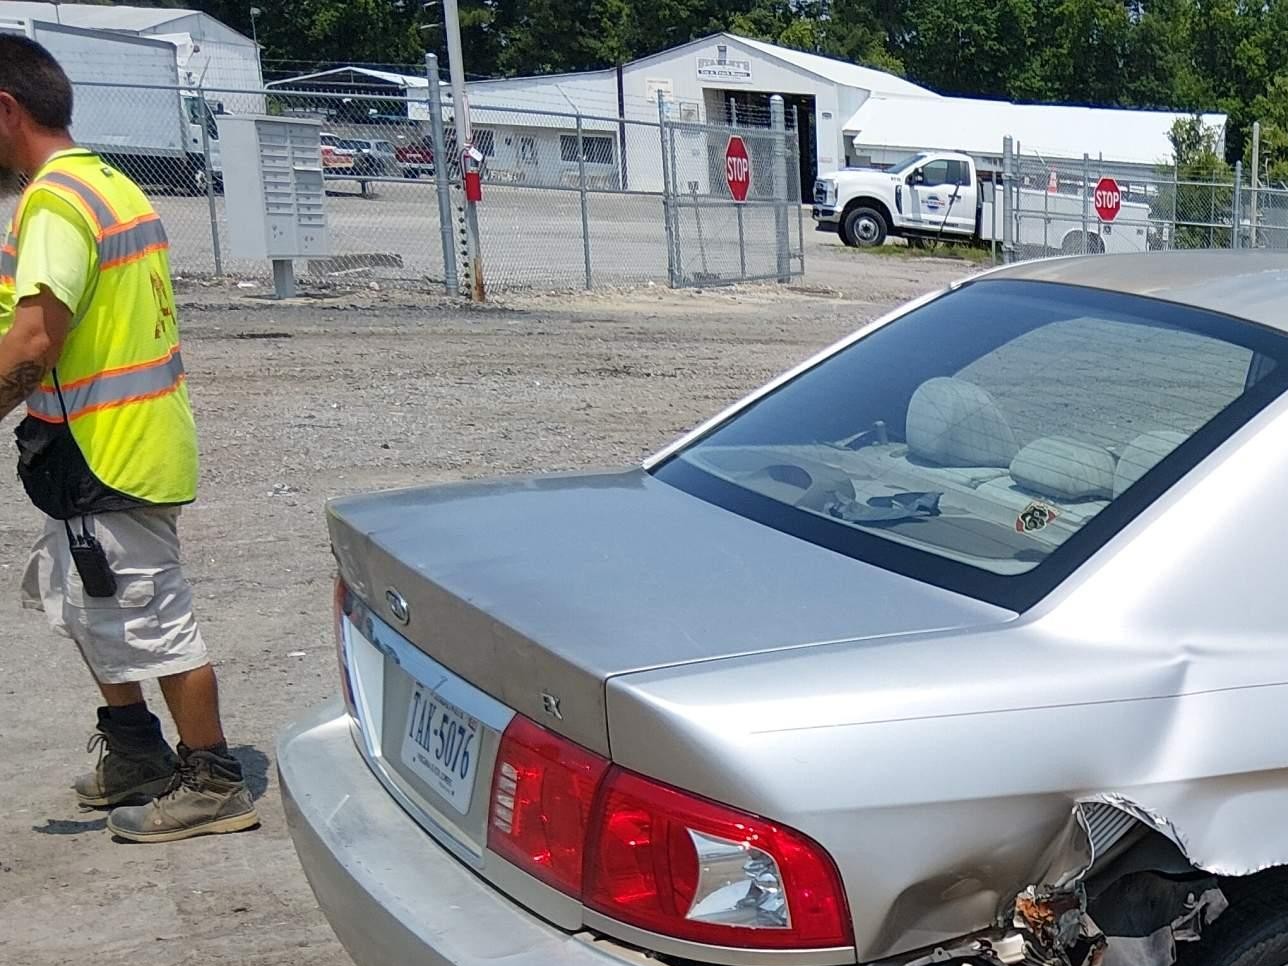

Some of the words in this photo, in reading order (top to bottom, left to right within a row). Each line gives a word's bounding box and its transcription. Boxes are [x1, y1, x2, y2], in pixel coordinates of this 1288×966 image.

[727, 156, 748, 182] STOP
[1096, 190, 1120, 209] STOP
[543, 693, 563, 720] EX
[409, 691, 474, 779] TAK-5076
